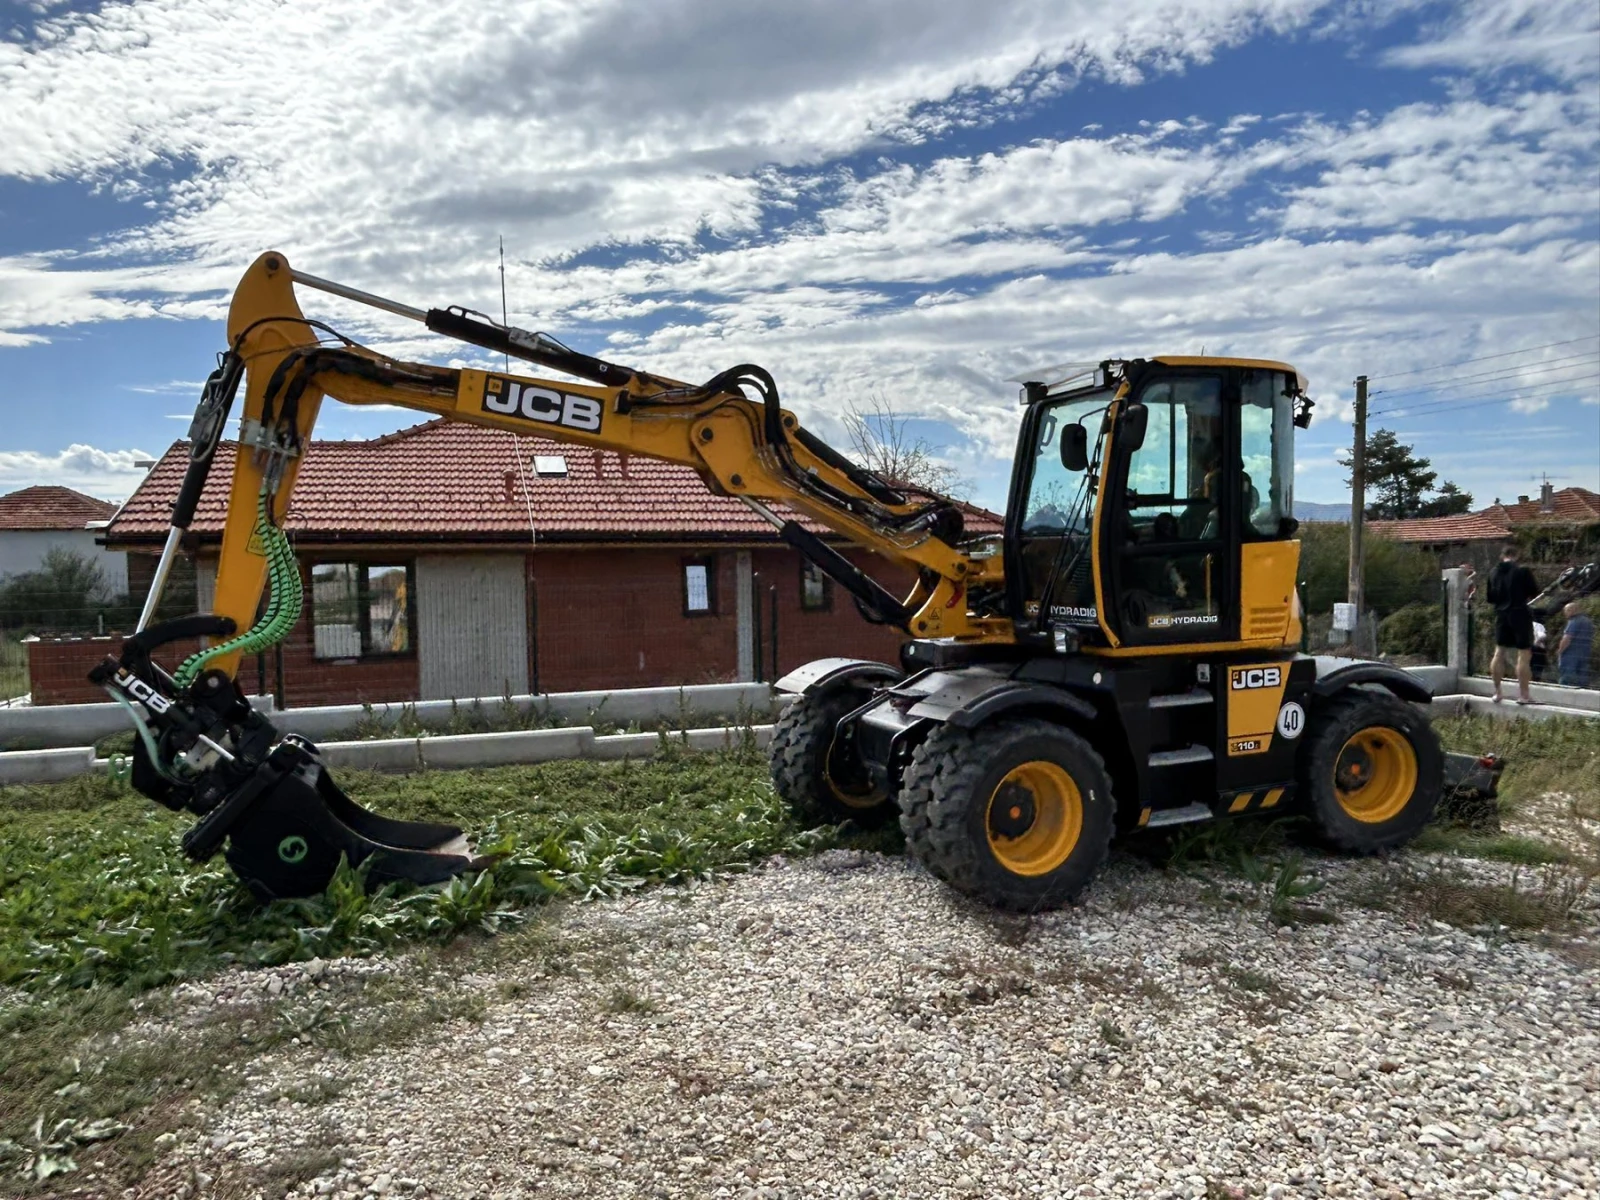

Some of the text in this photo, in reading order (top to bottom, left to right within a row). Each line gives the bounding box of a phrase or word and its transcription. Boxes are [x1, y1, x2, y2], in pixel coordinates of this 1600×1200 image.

[486, 382, 601, 430] JCB
[1150, 615, 1218, 625] JCB HYDRADIG
[1232, 668, 1281, 689] JCB
[114, 673, 171, 714] JCB
[1283, 709, 1299, 732] 40
